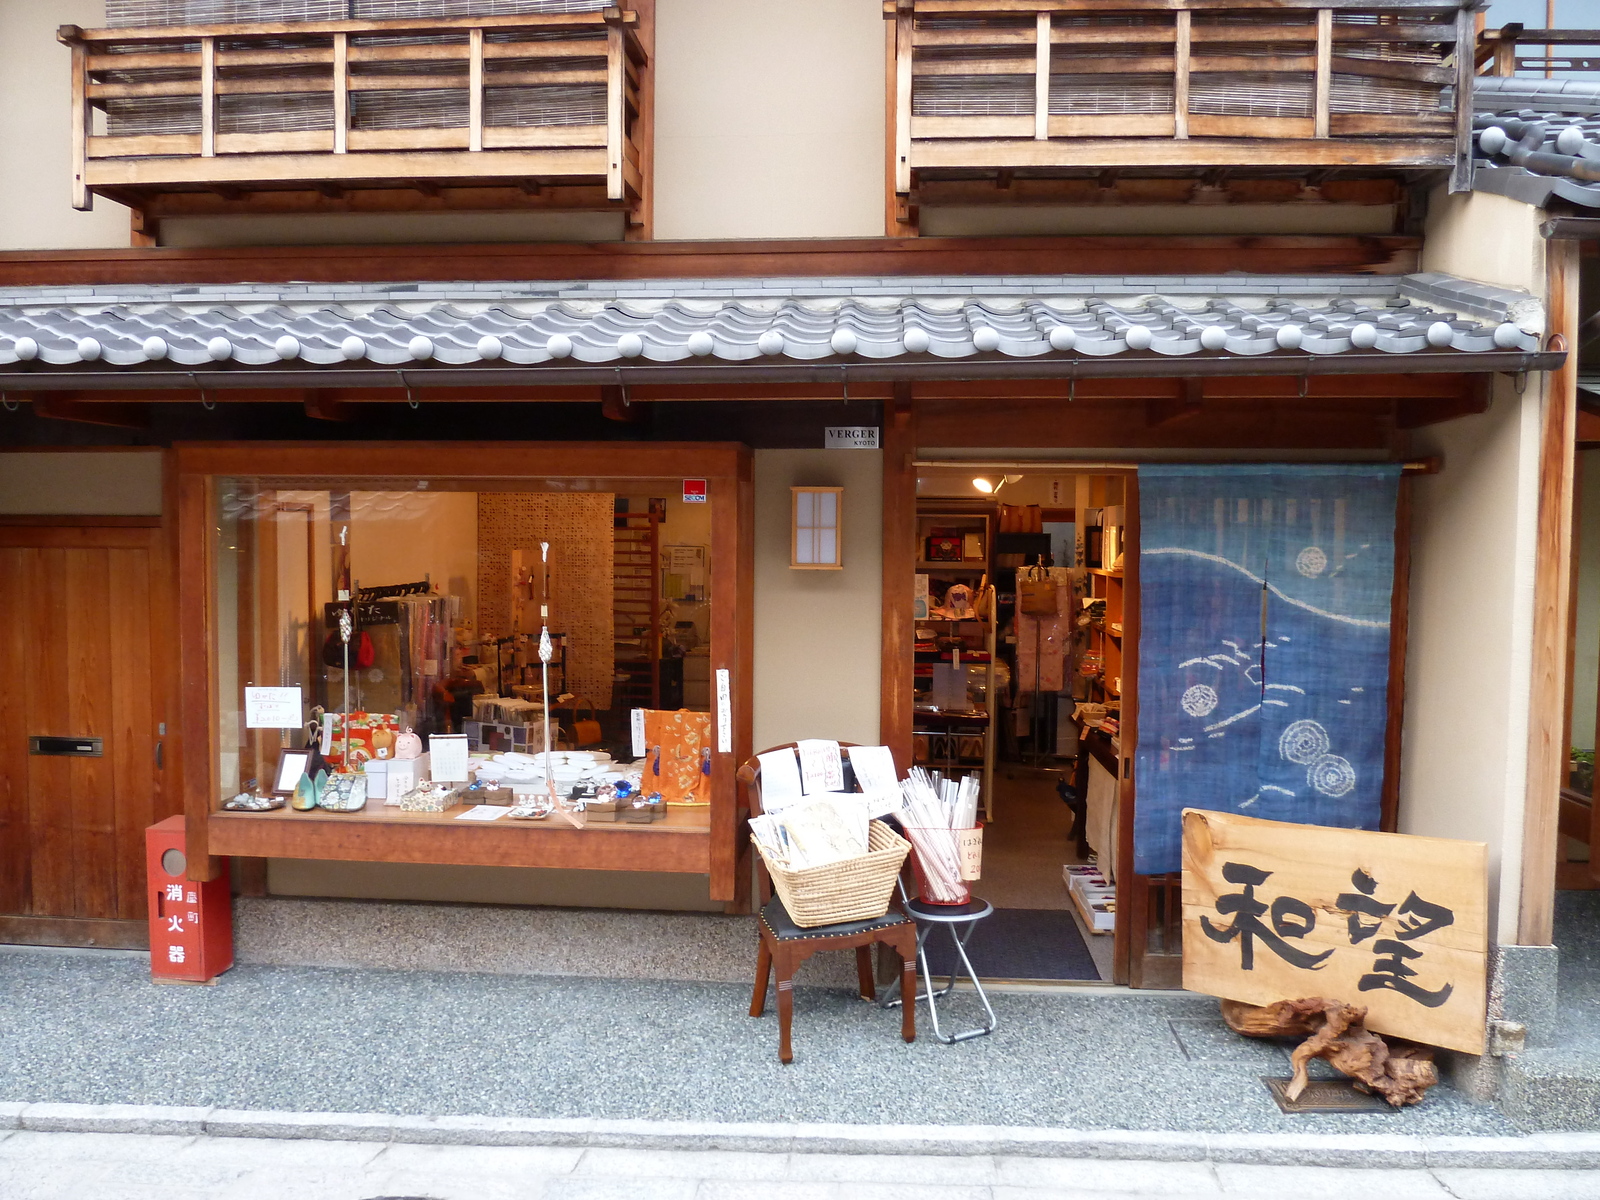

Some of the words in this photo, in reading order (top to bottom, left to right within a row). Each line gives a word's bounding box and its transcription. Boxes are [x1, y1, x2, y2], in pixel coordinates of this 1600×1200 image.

[828, 429, 875, 438] VERGER
[166, 884, 185, 963] 消火器
[1200, 861, 1454, 1008] 和望
